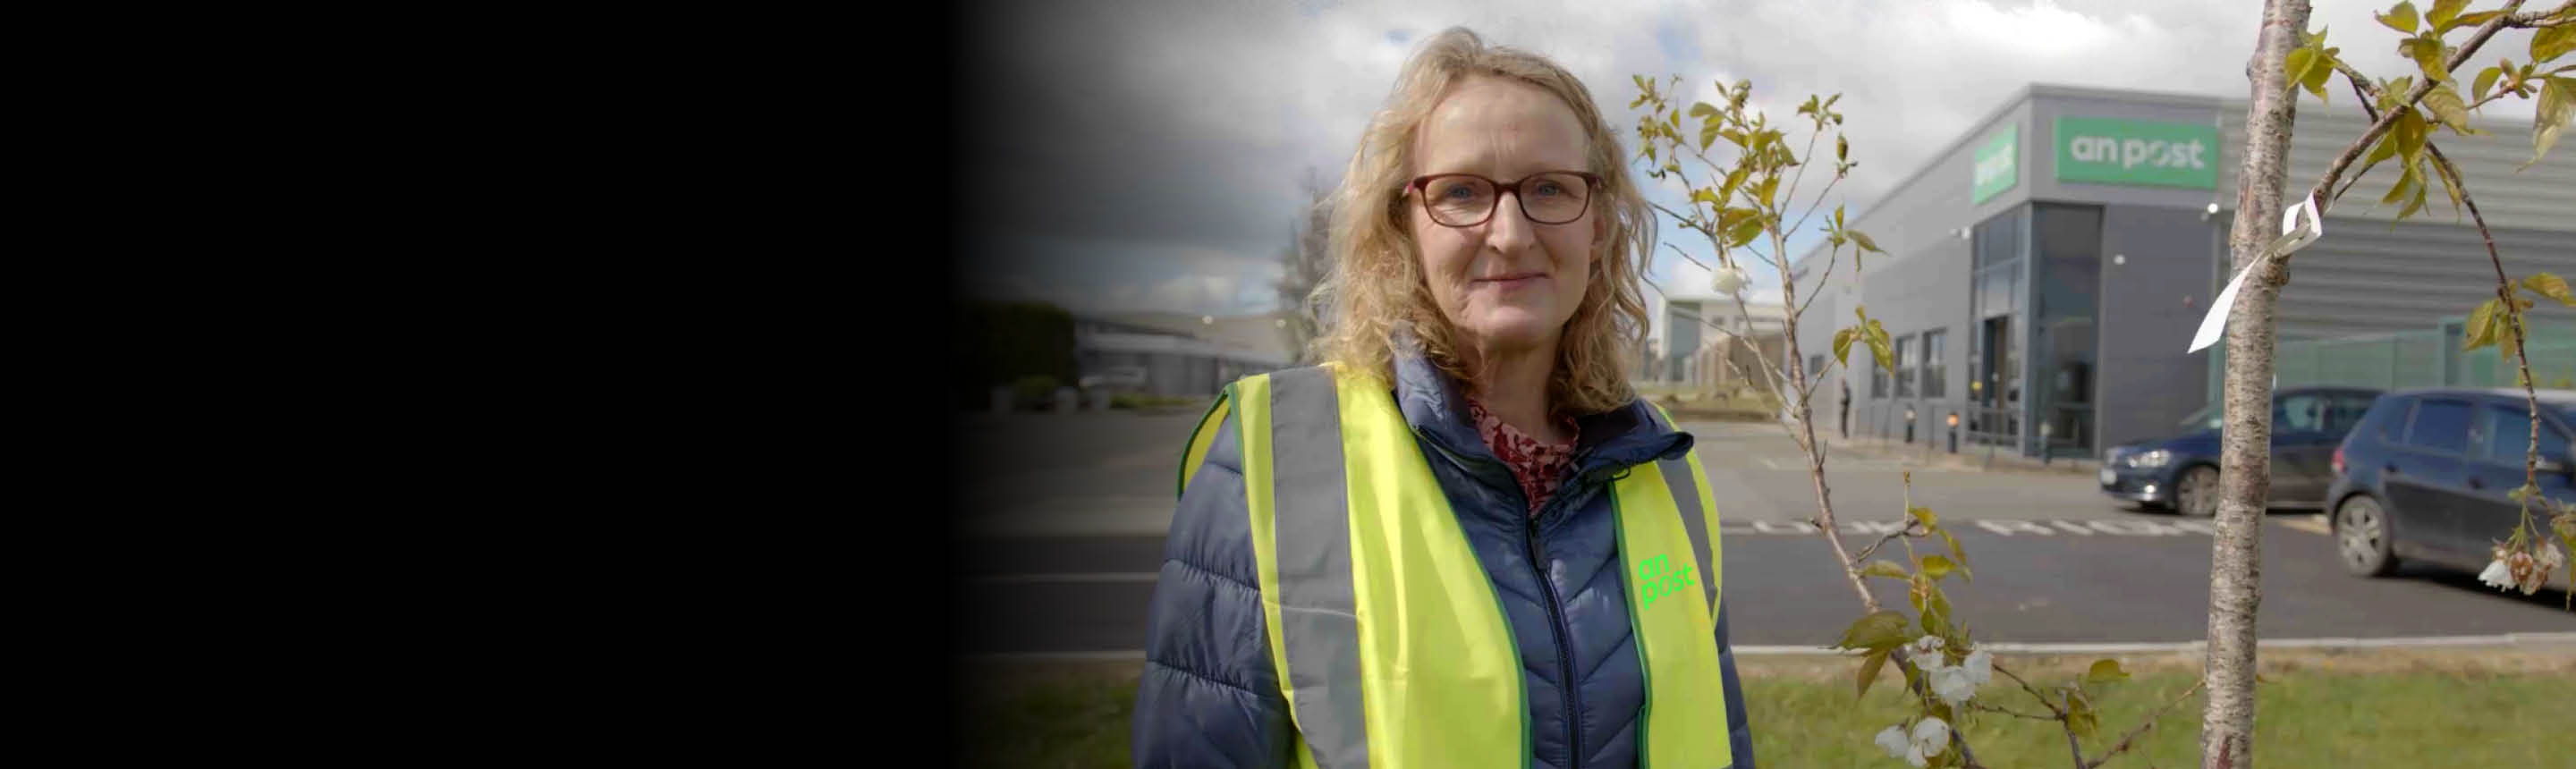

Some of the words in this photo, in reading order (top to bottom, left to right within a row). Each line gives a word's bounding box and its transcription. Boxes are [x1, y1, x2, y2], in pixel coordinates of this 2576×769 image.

[2070, 135, 2117, 162] an
[2123, 139, 2205, 169] post
[1639, 554, 1670, 580] an
[1641, 562, 1695, 611] post
